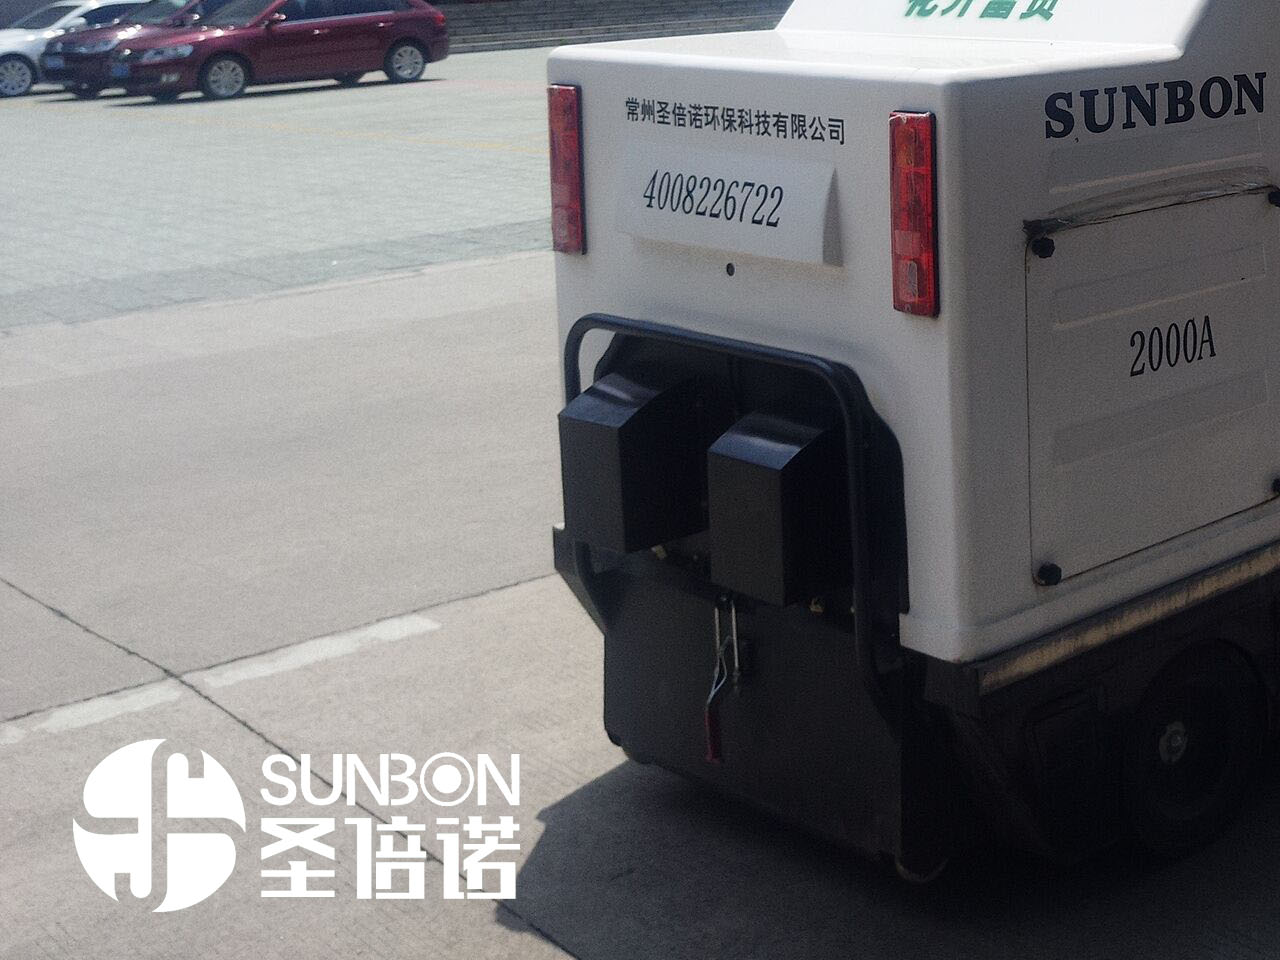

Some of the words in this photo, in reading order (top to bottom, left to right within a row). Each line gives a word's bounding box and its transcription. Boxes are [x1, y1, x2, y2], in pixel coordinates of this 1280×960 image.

[625, 96, 845, 146] 常州圣倍诺环保科技有限公司
[1044, 72, 1267, 139] SUNBON
[643, 169, 784, 228] 4008226722
[1129, 315, 1217, 377] 2000A
